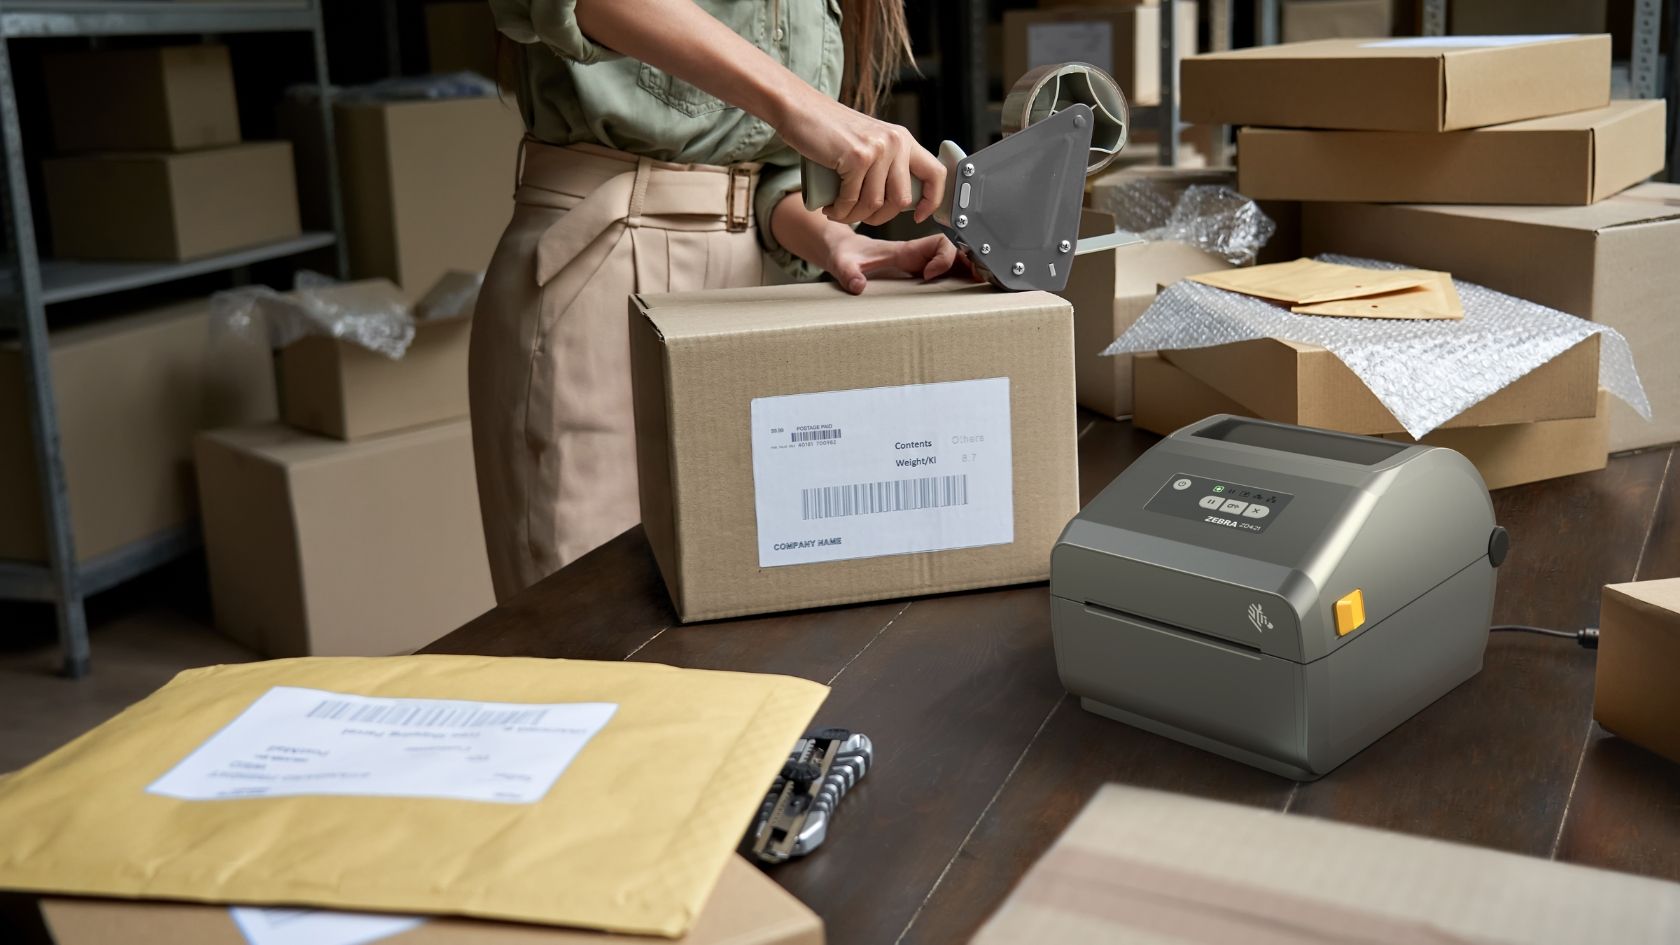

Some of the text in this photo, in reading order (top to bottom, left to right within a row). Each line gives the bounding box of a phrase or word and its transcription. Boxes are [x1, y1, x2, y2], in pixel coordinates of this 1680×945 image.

[895, 435, 984, 450] Contents Others
[962, 454, 976, 462] 8.7
[1204, 516, 1238, 528] ZEBRA
[773, 537, 842, 551] COMPANY NAME
